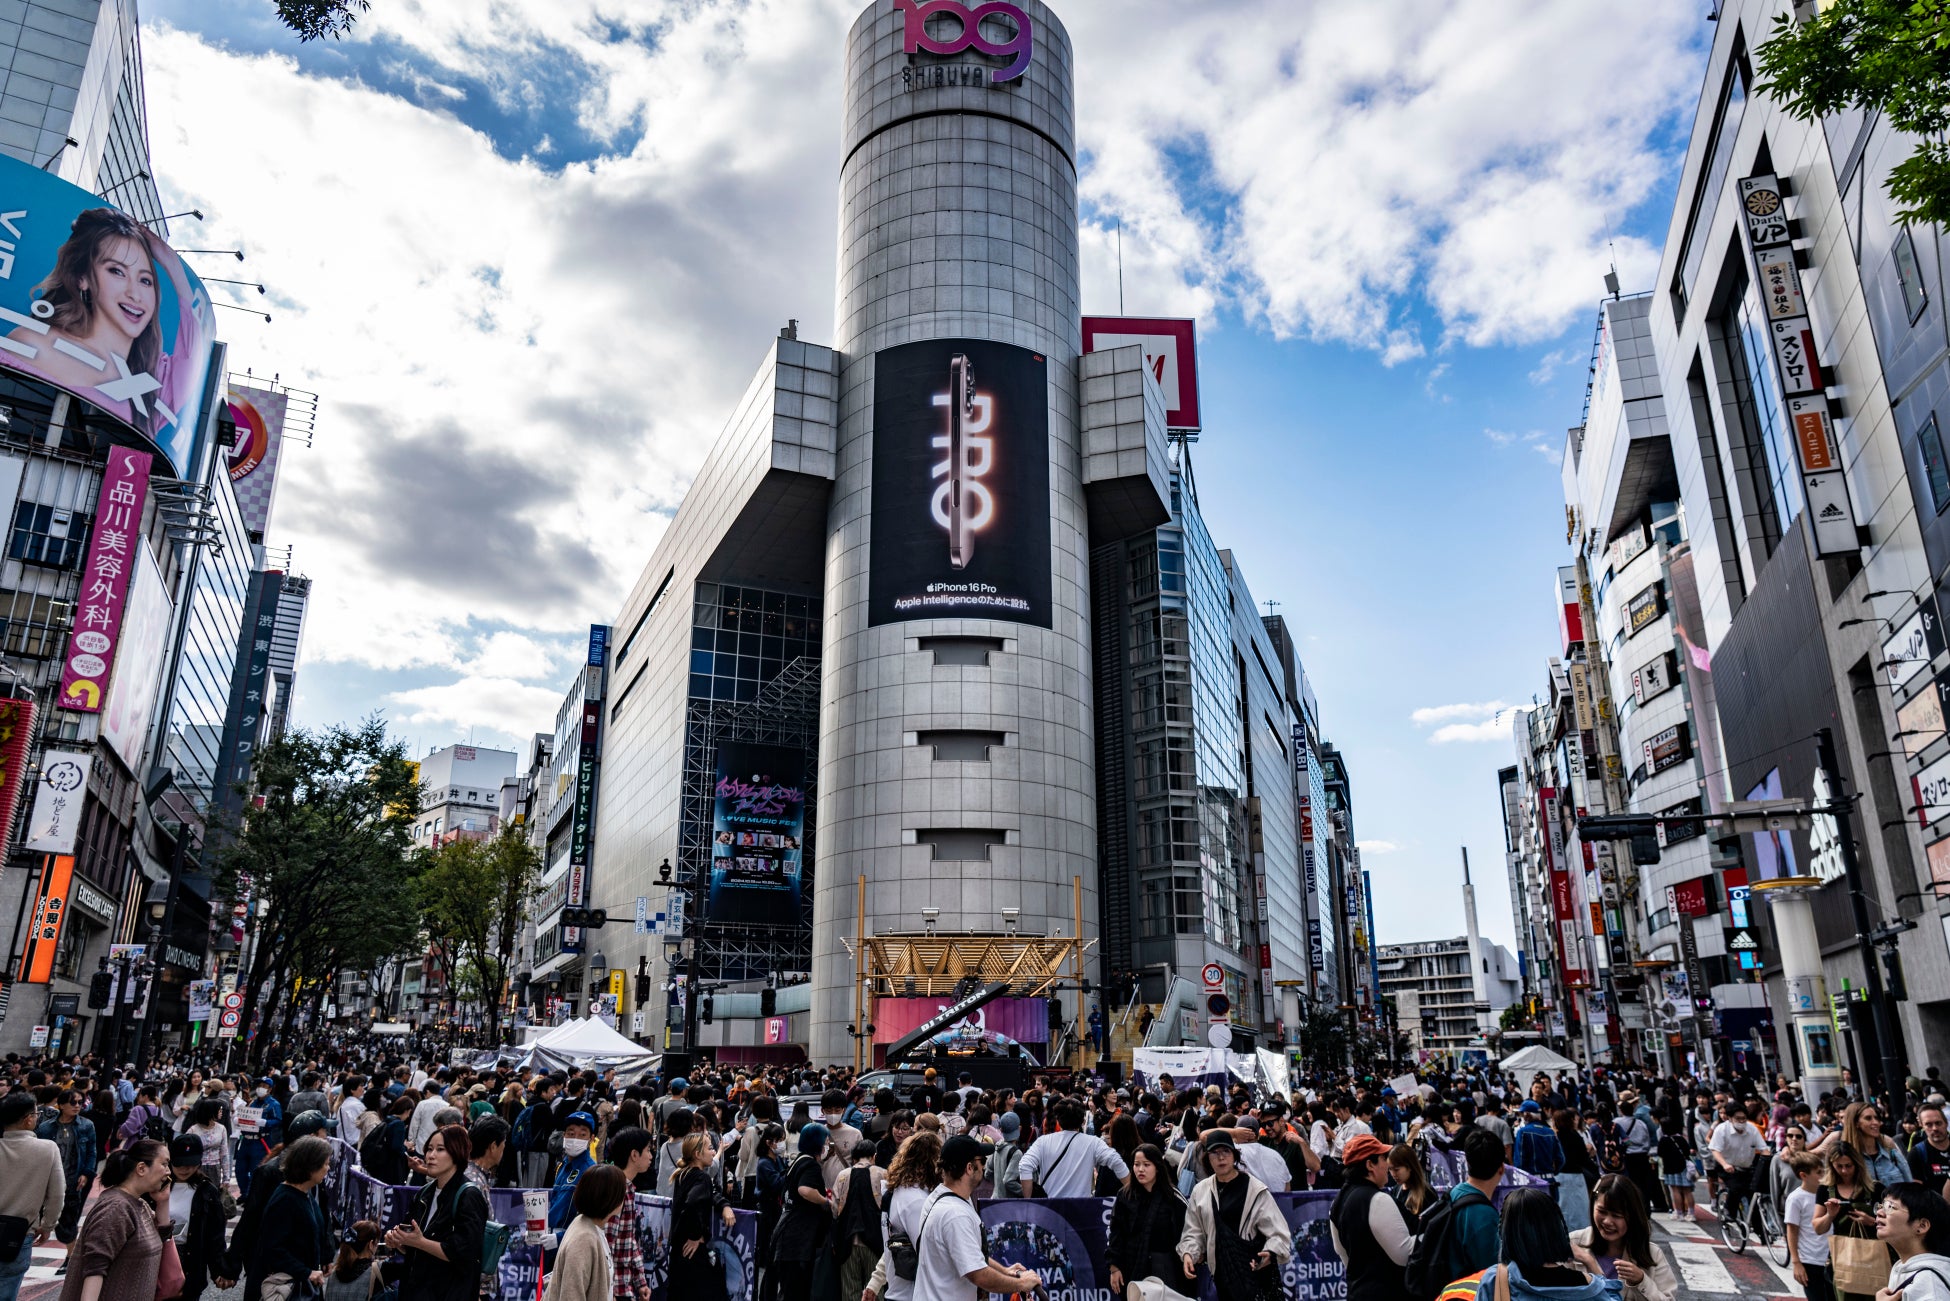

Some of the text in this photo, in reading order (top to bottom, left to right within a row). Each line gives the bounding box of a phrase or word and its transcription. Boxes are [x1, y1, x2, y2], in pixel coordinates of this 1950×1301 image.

[893, 0, 1033, 82] 109
[1751, 215, 1783, 226] Darts
[1751, 224, 1787, 243] UP
[1781, 335, 1804, 389] スシロー
[930, 394, 993, 531] PRO
[1819, 510, 1844, 518] adidas
[83, 478, 137, 631] 品川美容外科
[894, 597, 921, 609] Apple
[934, 583, 997, 593] iPhone 16 Pro
[1908, 629, 1924, 658] UP
[238, 614, 273, 781] 渋東シネタワー
[1295, 739, 1308, 769] LABI
[55, 762, 75, 792] つかだ
[46, 796, 66, 837] 地どり屋
[1300, 806, 1313, 841] LABI
[1304, 849, 1316, 894] SHIBUYA
[77, 884, 101, 913] EXCELSIOR
[1310, 934, 1322, 968] LABI
[1566, 933, 1577, 966] SoftBank
[1683, 930, 1694, 954] SAINT
[1689, 958, 1699, 982] LOUIS
[1206, 969, 1220, 981] 30
[228, 997, 240, 1005] 40
[920, 989, 987, 1033] DJ TRITON
[1800, 995, 1812, 1008] 2
